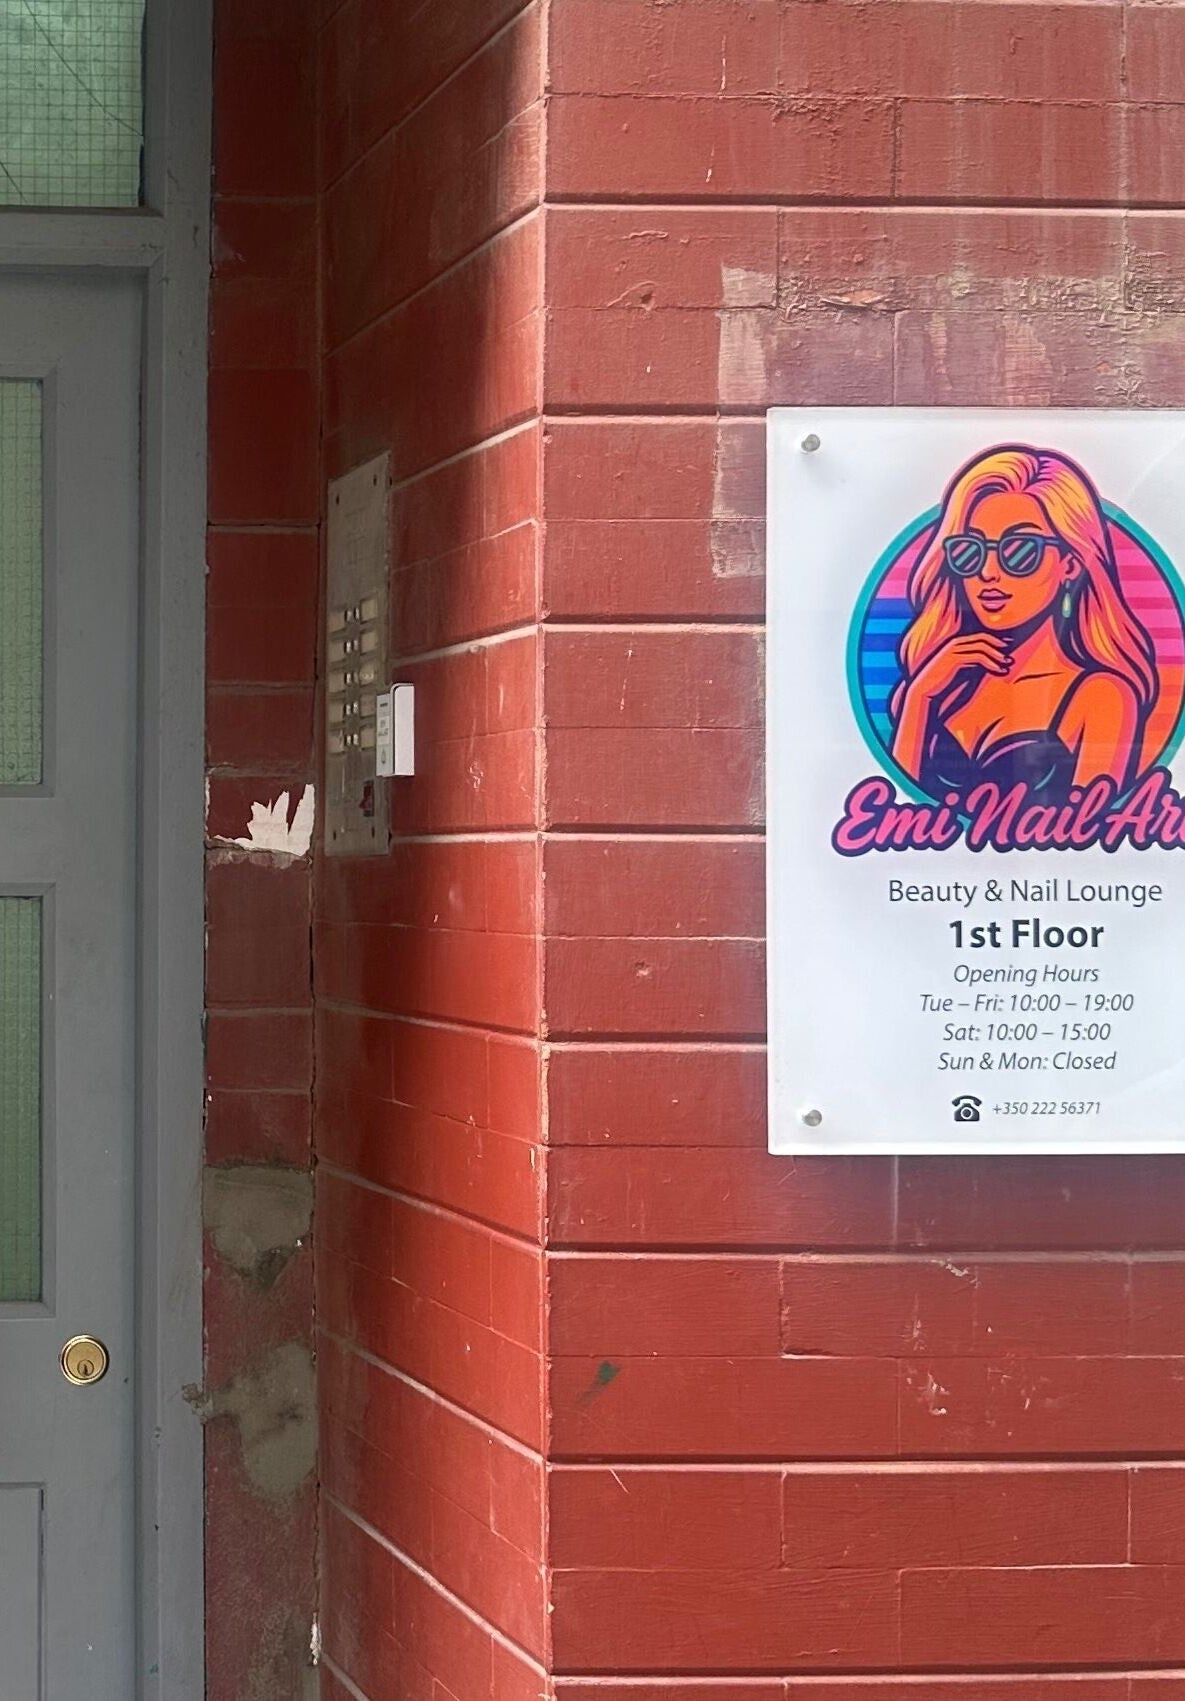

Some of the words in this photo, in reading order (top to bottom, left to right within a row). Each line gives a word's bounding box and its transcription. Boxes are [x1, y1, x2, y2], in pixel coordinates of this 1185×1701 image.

[833, 778, 963, 855] Emi
[965, 779, 1113, 853] Nail
[888, 879, 978, 909] Beauty
[984, 878, 1003, 903] &
[1010, 877, 1059, 902] Nail
[1066, 879, 1163, 908] Lounge
[948, 919, 1002, 949] 1st
[1011, 917, 1105, 949] Floor
[953, 964, 1038, 988] Opening
[1042, 963, 1101, 983] Hours
[919, 993, 954, 1012] Tue
[974, 993, 1005, 1012] Fri:
[1010, 993, 1061, 1012] 10:00
[1084, 993, 1135, 1012] 19:00
[942, 1022, 982, 1042] Sat:
[987, 1023, 1038, 1041] 10:00
[1061, 1022, 1112, 1041] 15:00
[937, 1051, 975, 1071] Sun
[978, 1051, 995, 1071] &
[997, 1051, 1049, 1071] Mon:
[1052, 1050, 1118, 1070] Closed
[992, 1101, 1029, 1115] +350
[1030, 1101, 1057, 1115] 222
[1059, 1101, 1102, 1115] 56371
